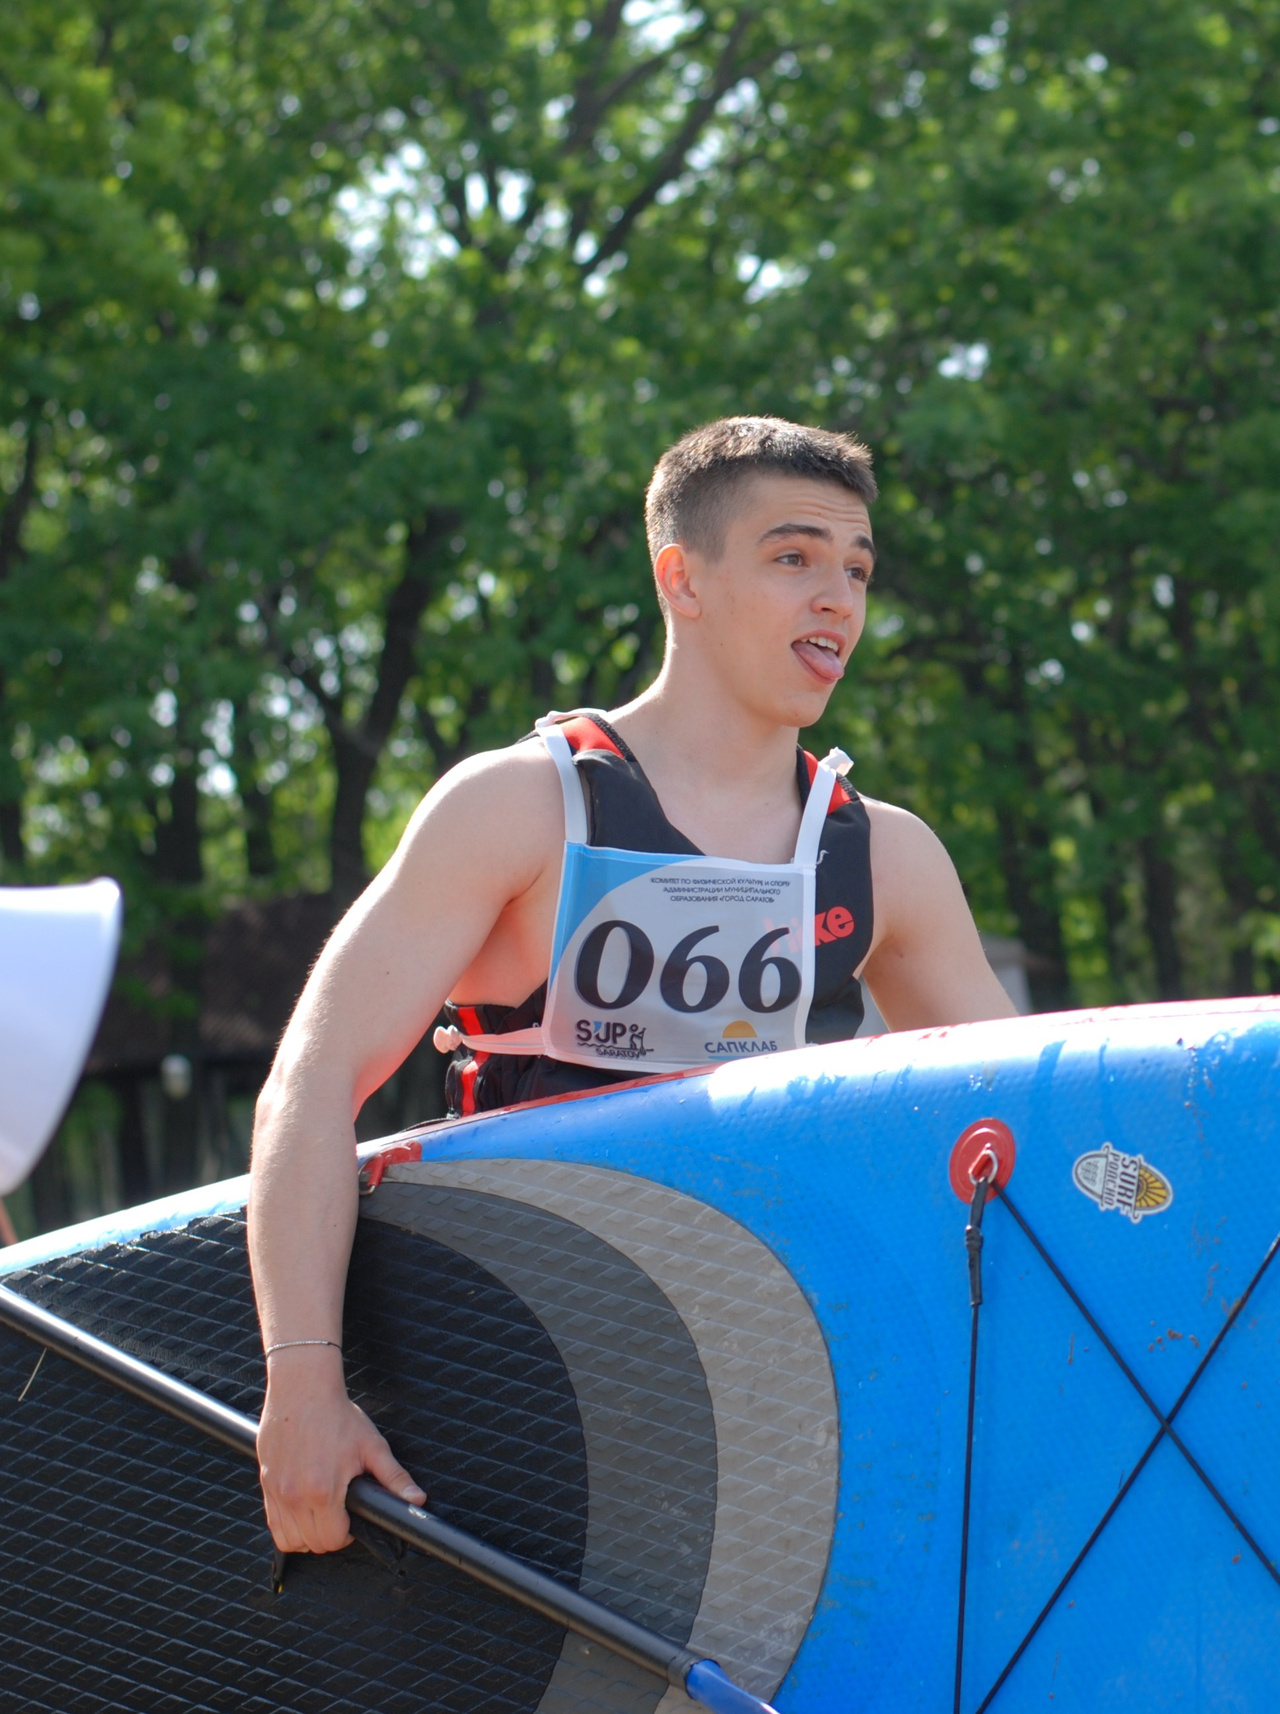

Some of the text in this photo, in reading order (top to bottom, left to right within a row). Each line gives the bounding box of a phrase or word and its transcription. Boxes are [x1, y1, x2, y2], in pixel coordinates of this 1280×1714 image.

[574, 919, 802, 1014] 066
[576, 1019, 627, 1045] SUP
[703, 1040, 778, 1054] САПКЛАБ
[1103, 1152, 1121, 1207] PONCHO
[1116, 1156, 1138, 1216] SURF
